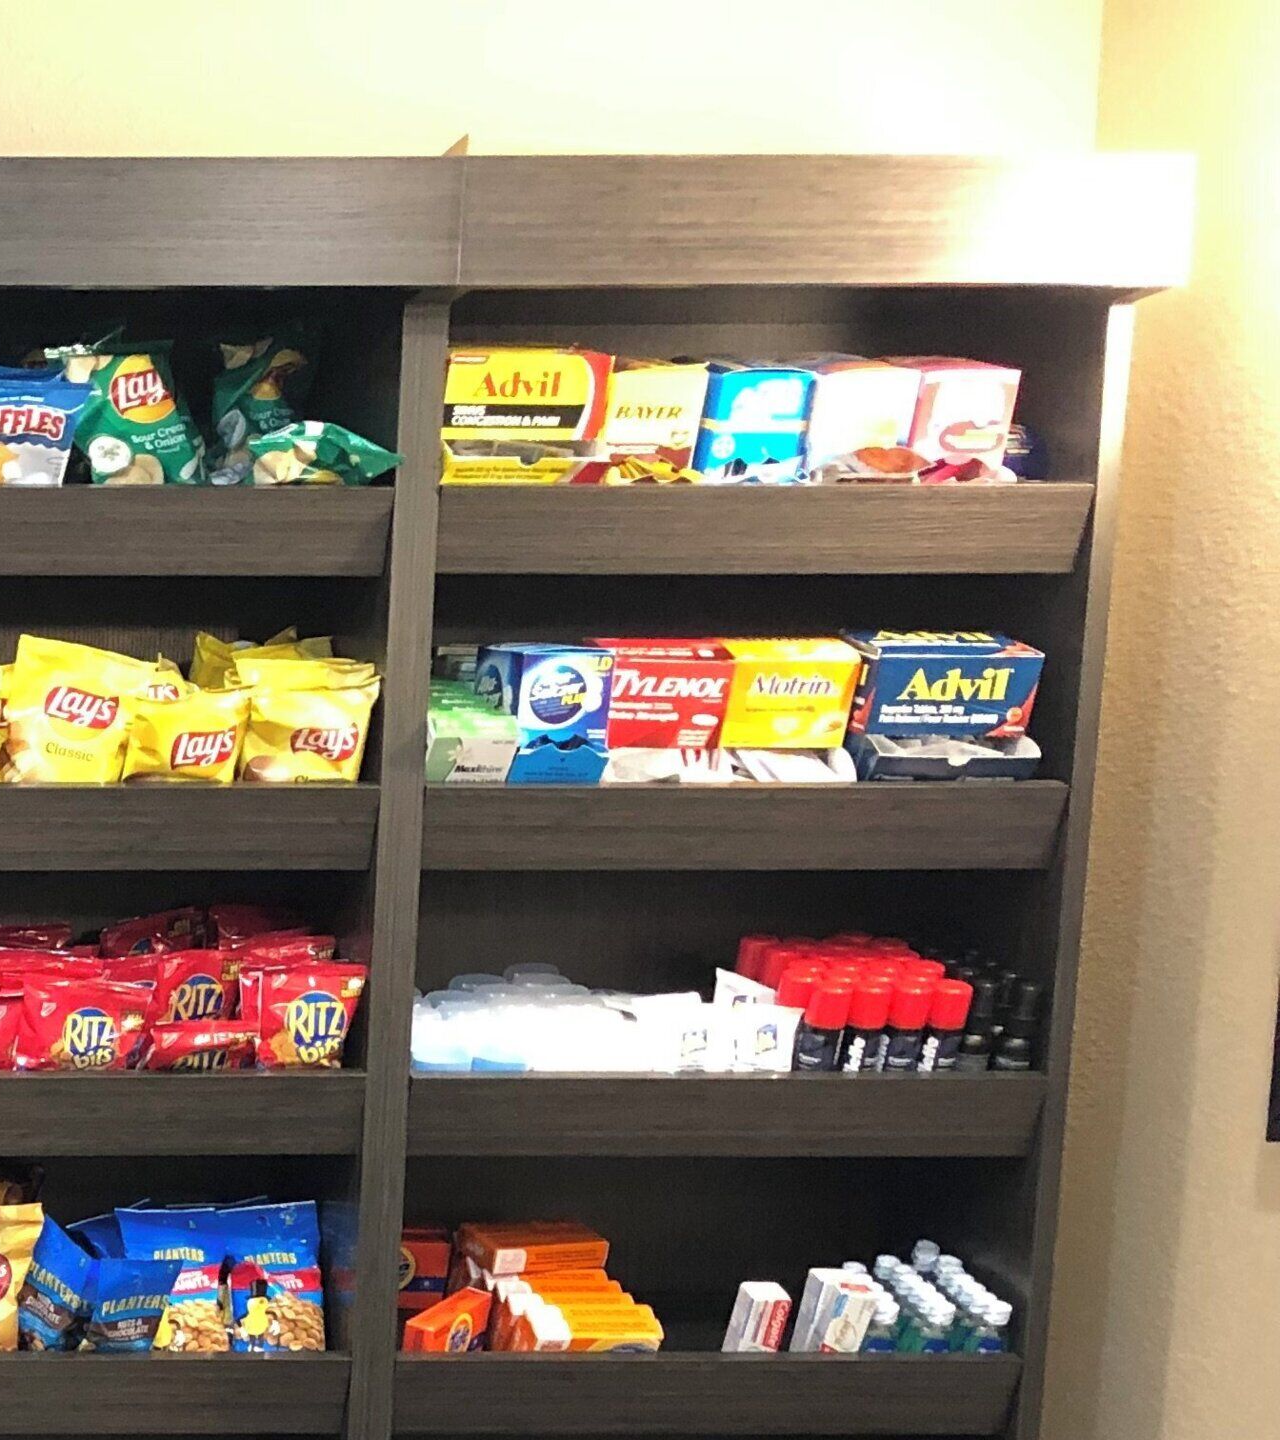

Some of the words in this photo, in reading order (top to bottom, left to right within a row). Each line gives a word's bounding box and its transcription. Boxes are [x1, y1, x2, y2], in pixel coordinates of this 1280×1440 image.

[116, 369, 168, 410] Lay
[473, 371, 562, 398] Advil
[615, 405, 683, 419] BAYER
[131, 432, 155, 444] Sour
[145, 439, 153, 450] &
[613, 669, 726, 698] TYLENOL
[755, 675, 832, 695] Motrin
[896, 667, 1011, 701] Advil
[45, 742, 94, 762] Classic
[170, 983, 224, 1022] RITZ
[64, 1012, 115, 1051] RITZ
[285, 1001, 346, 1047] RITZ
[73, 1046, 114, 1069] bits
[153, 1247, 205, 1263] PLANTERS
[244, 1251, 298, 1266] PLANTERS
[101, 1294, 170, 1317] PLANTERS
